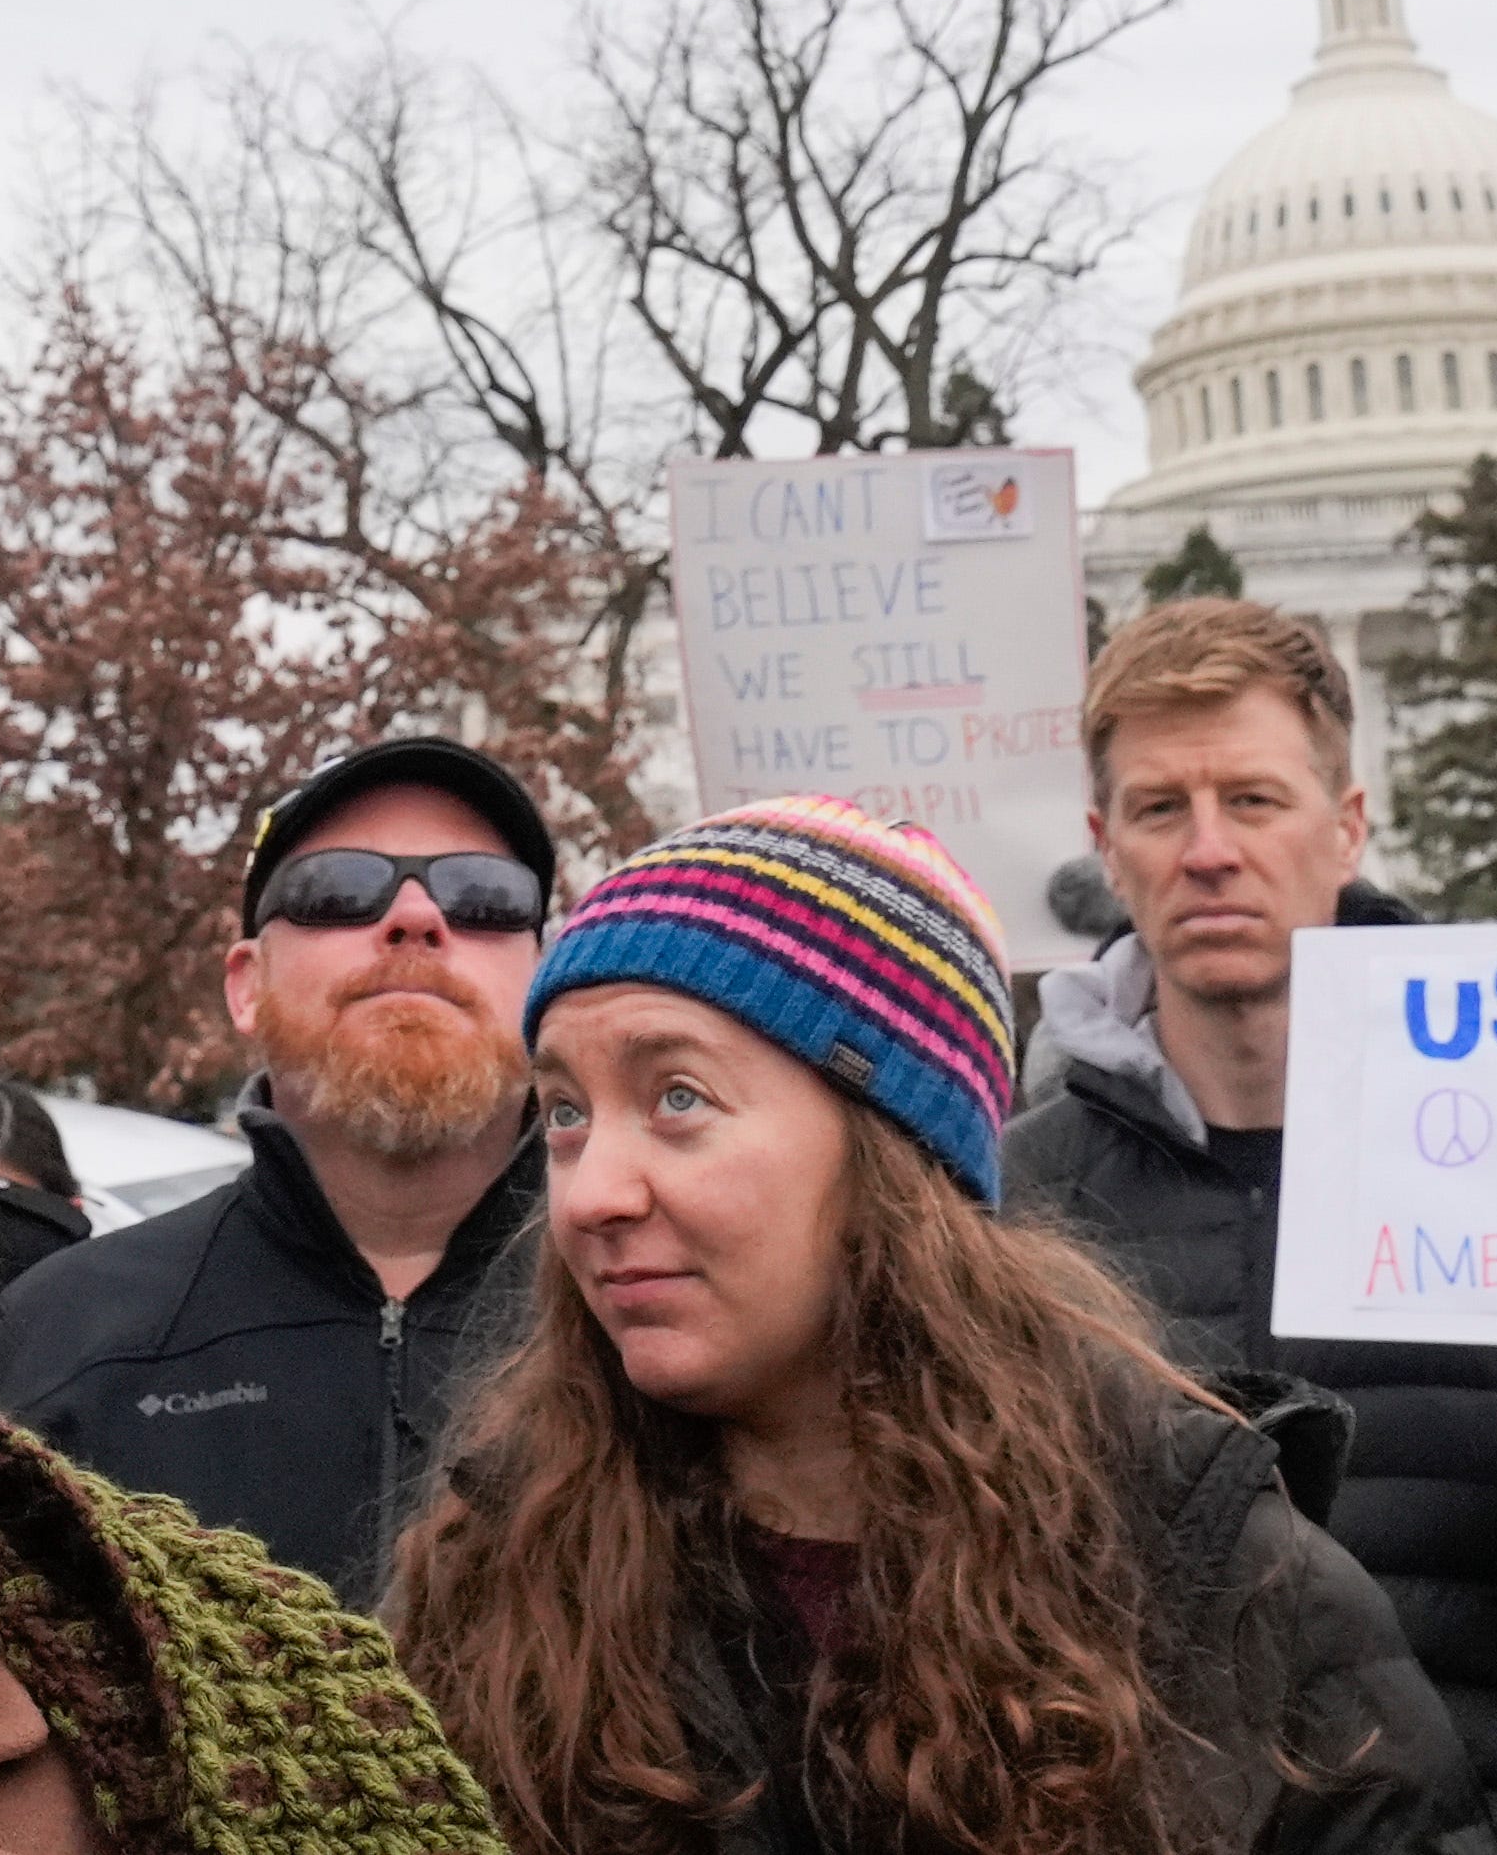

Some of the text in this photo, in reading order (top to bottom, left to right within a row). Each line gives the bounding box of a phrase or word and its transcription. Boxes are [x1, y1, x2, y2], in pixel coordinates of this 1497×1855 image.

[687, 477, 737, 545] I
[708, 556, 946, 632] BELIEVE
[715, 638, 988, 701] WE STILL
[728, 704, 1079, 773] HAVE TO PROTE
